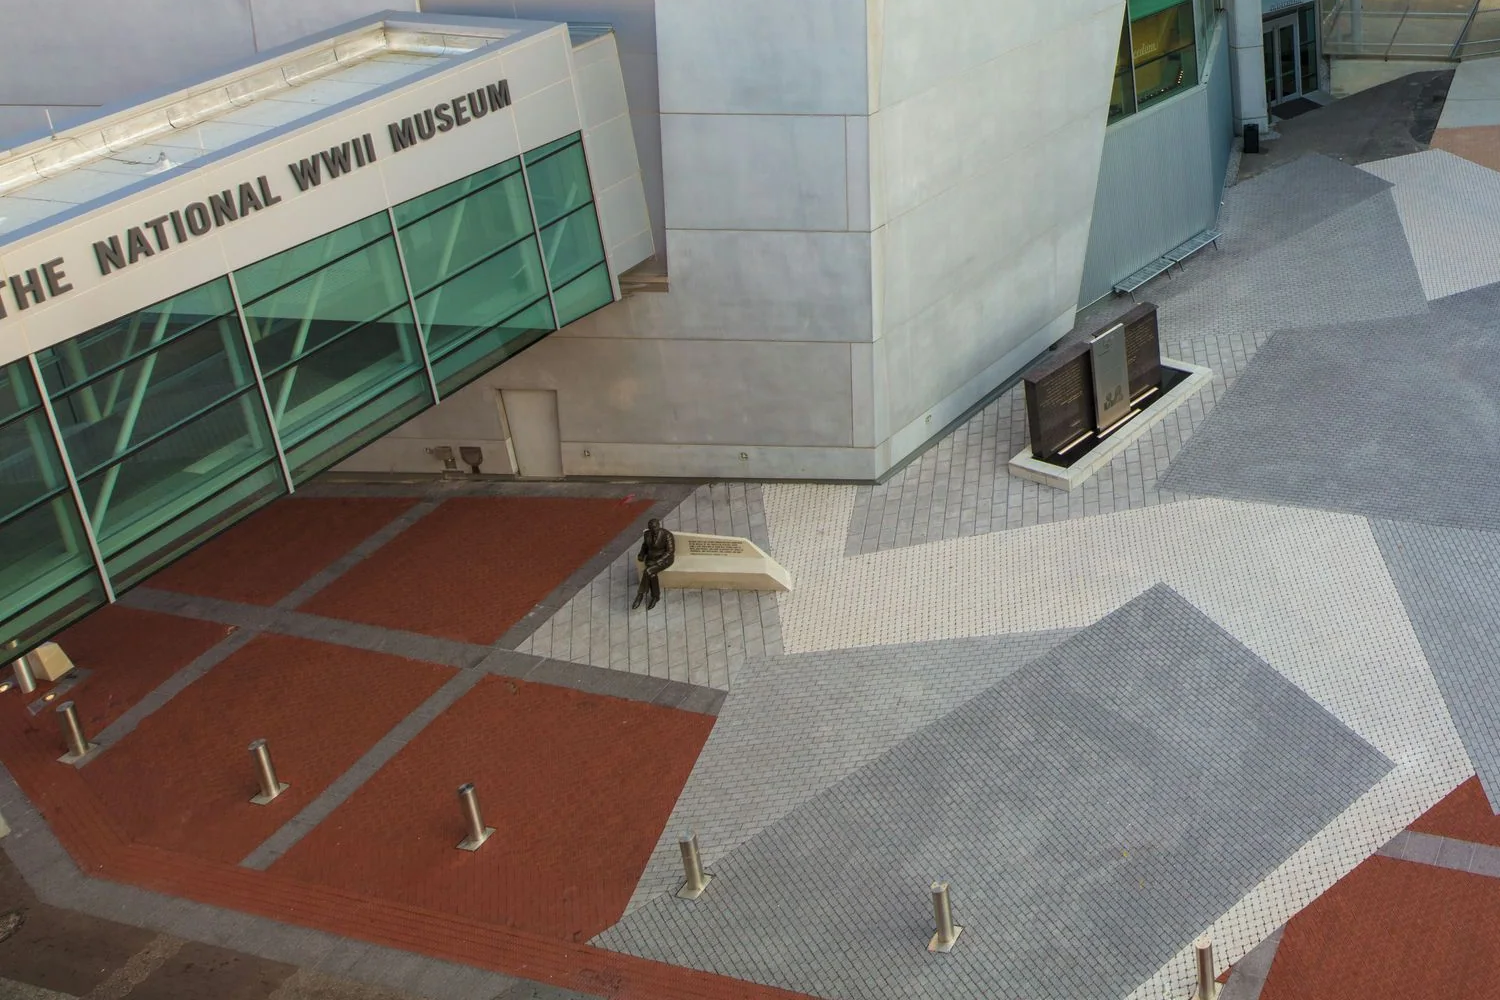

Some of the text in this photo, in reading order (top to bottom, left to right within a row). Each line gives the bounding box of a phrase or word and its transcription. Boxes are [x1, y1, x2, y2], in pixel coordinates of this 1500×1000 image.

[93, 175, 282, 276] NATIONAL
[288, 133, 377, 192] WWII
[387, 79, 512, 153] MUSEUM
